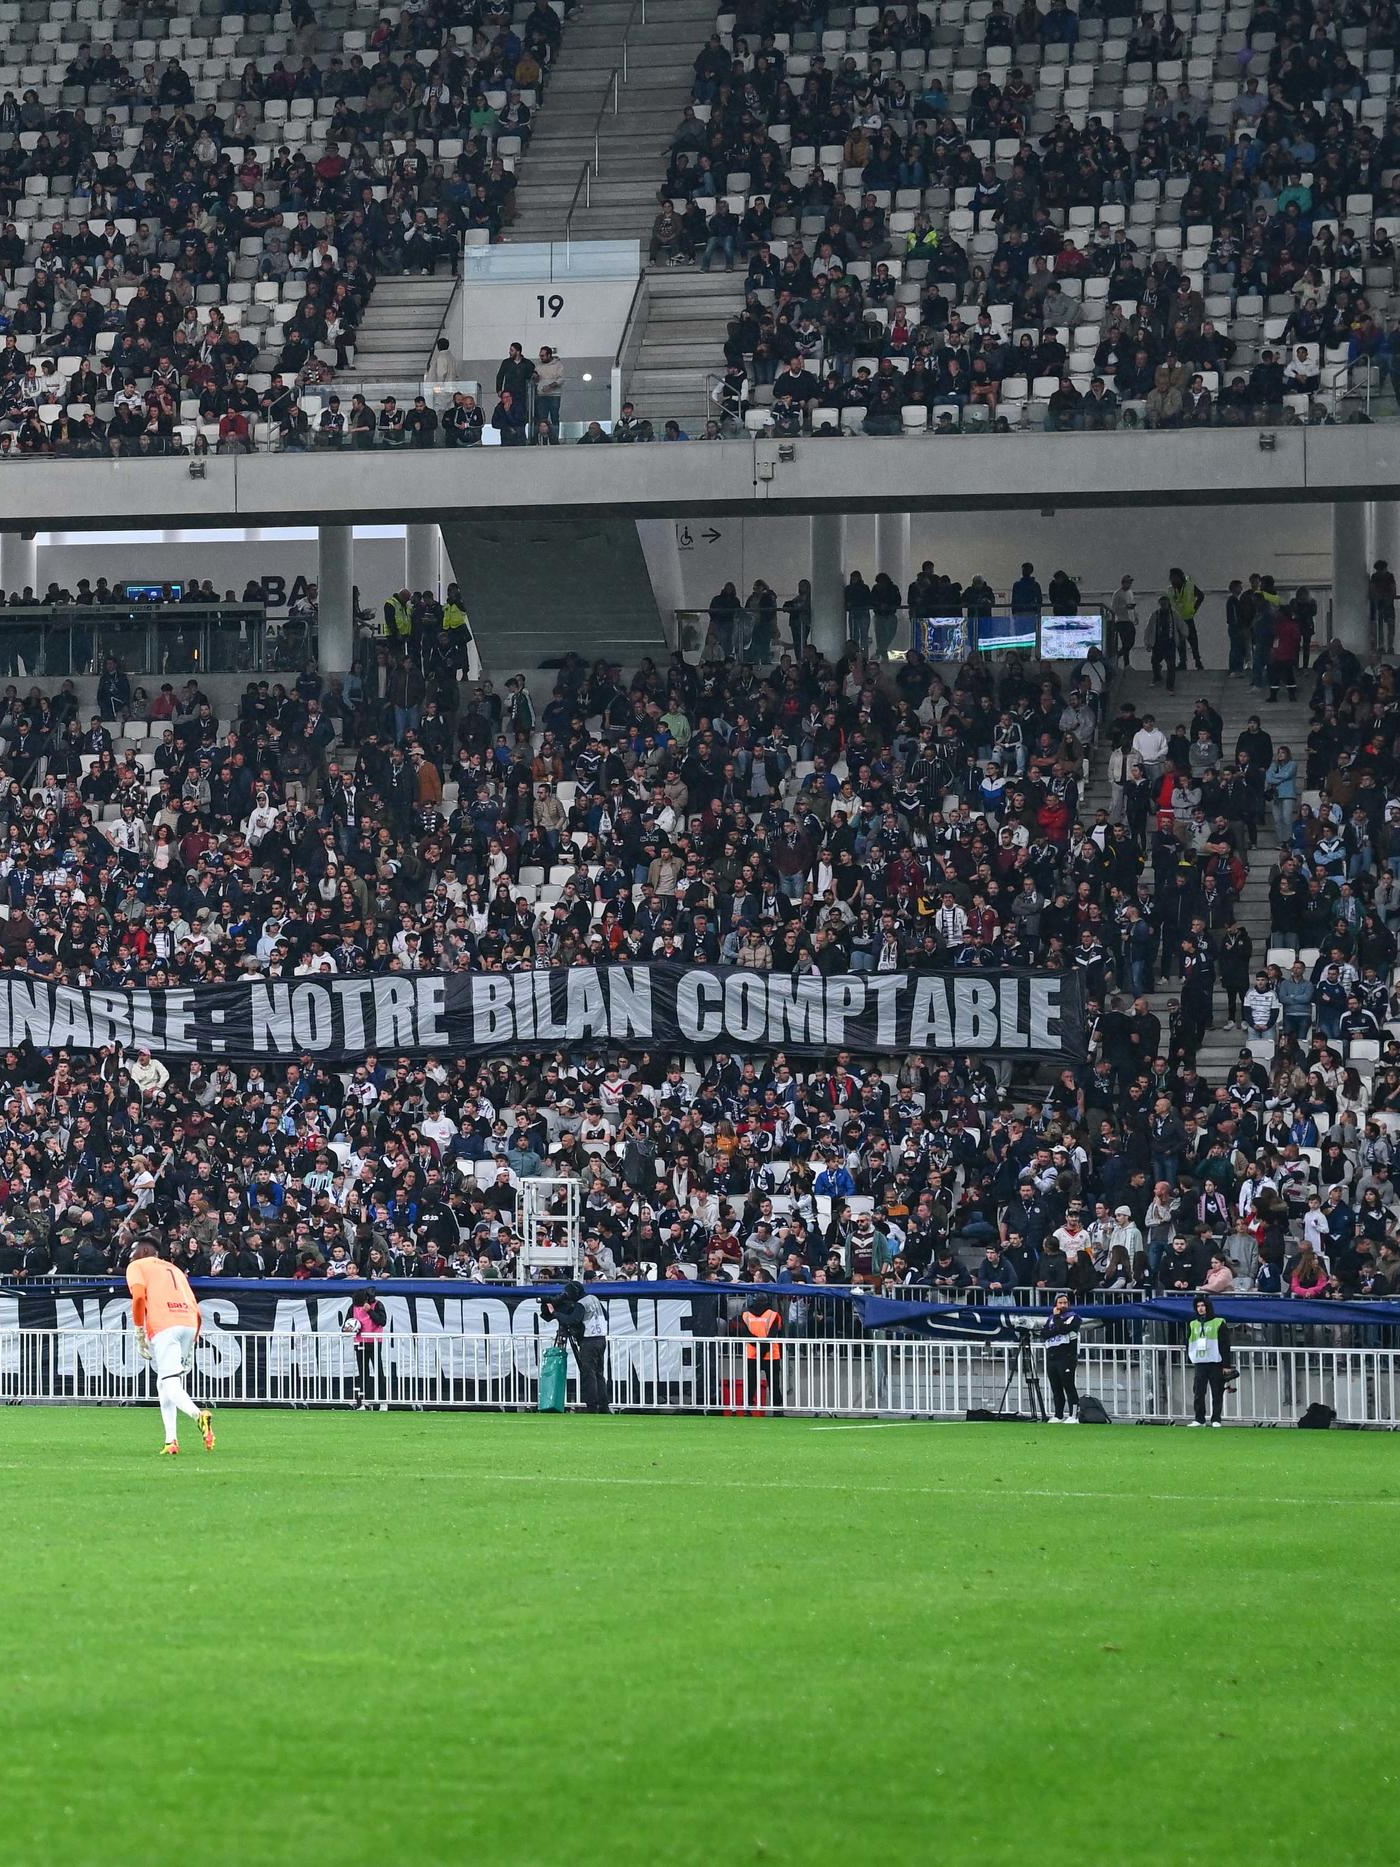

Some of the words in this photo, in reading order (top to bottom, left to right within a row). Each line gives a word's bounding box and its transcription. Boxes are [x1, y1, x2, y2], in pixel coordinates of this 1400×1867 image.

[537, 295, 564, 318] 19
[261, 575, 319, 607] BA
[252, 975, 450, 1052] NOTRE
[472, 966, 652, 1043] BILAN
[677, 969, 1062, 1050] COMPTABLE
[166, 1268, 178, 1290] 1
[55, 1298, 242, 1379] NOS
[269, 1296, 701, 1383] ABANDONE
